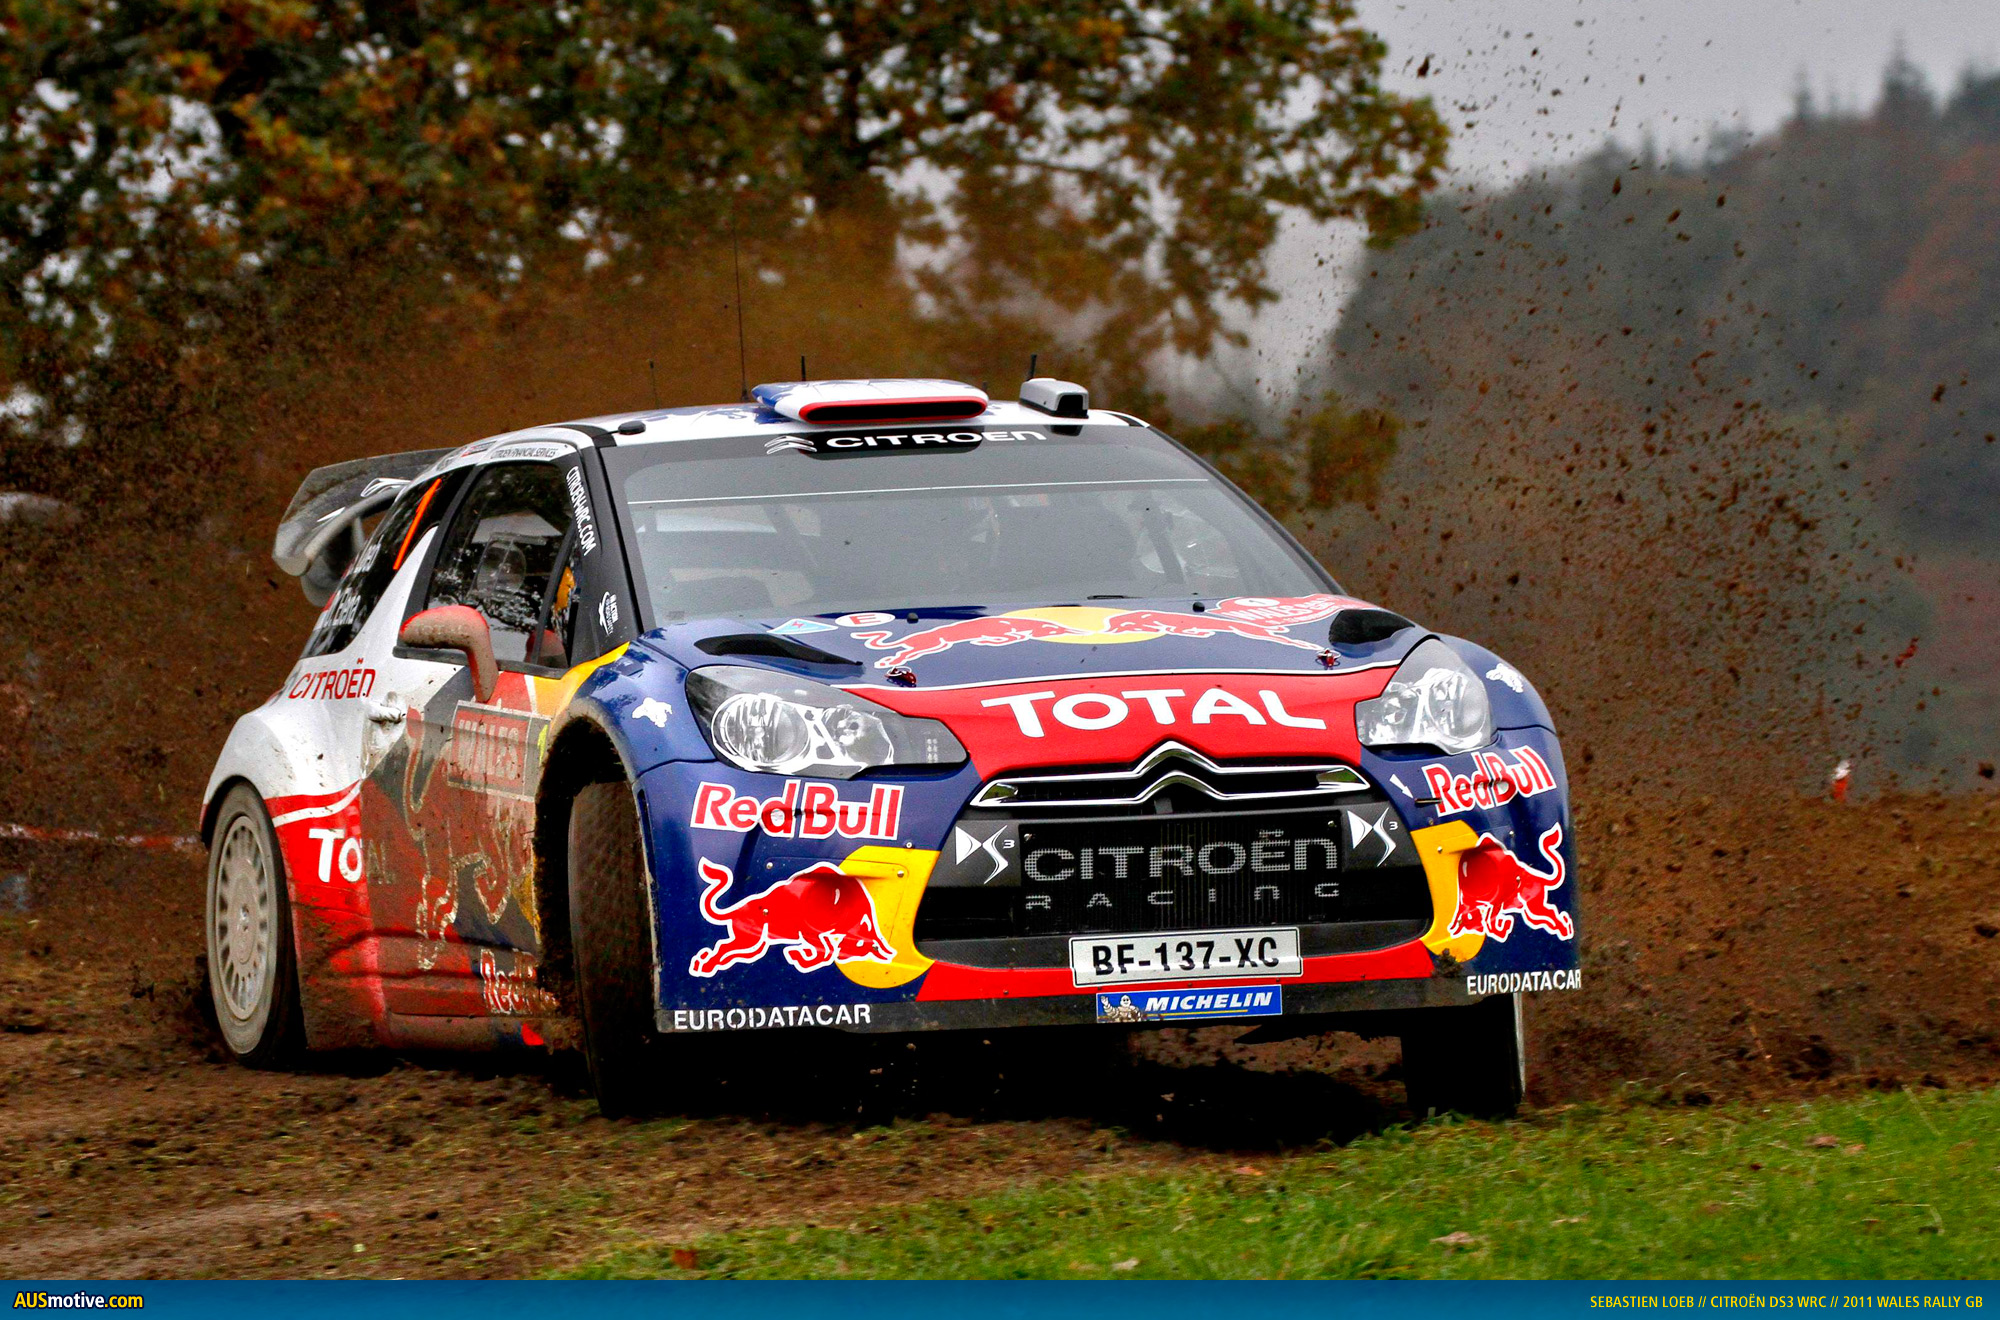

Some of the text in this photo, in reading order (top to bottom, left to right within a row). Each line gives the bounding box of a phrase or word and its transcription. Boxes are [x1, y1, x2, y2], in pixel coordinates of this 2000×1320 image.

[826, 430, 1047, 448] CITROEN
[288, 658, 376, 700] CITROËN
[980, 687, 1327, 738] TOTAL
[1024, 829, 1338, 881] CITROËN
[1092, 936, 1280, 976] BF-137-XC
[1466, 968, 1582, 996] EURODATACAR
[674, 1003, 871, 1030] EURODATACAR
[1144, 990, 1274, 1011] MICHELIN
